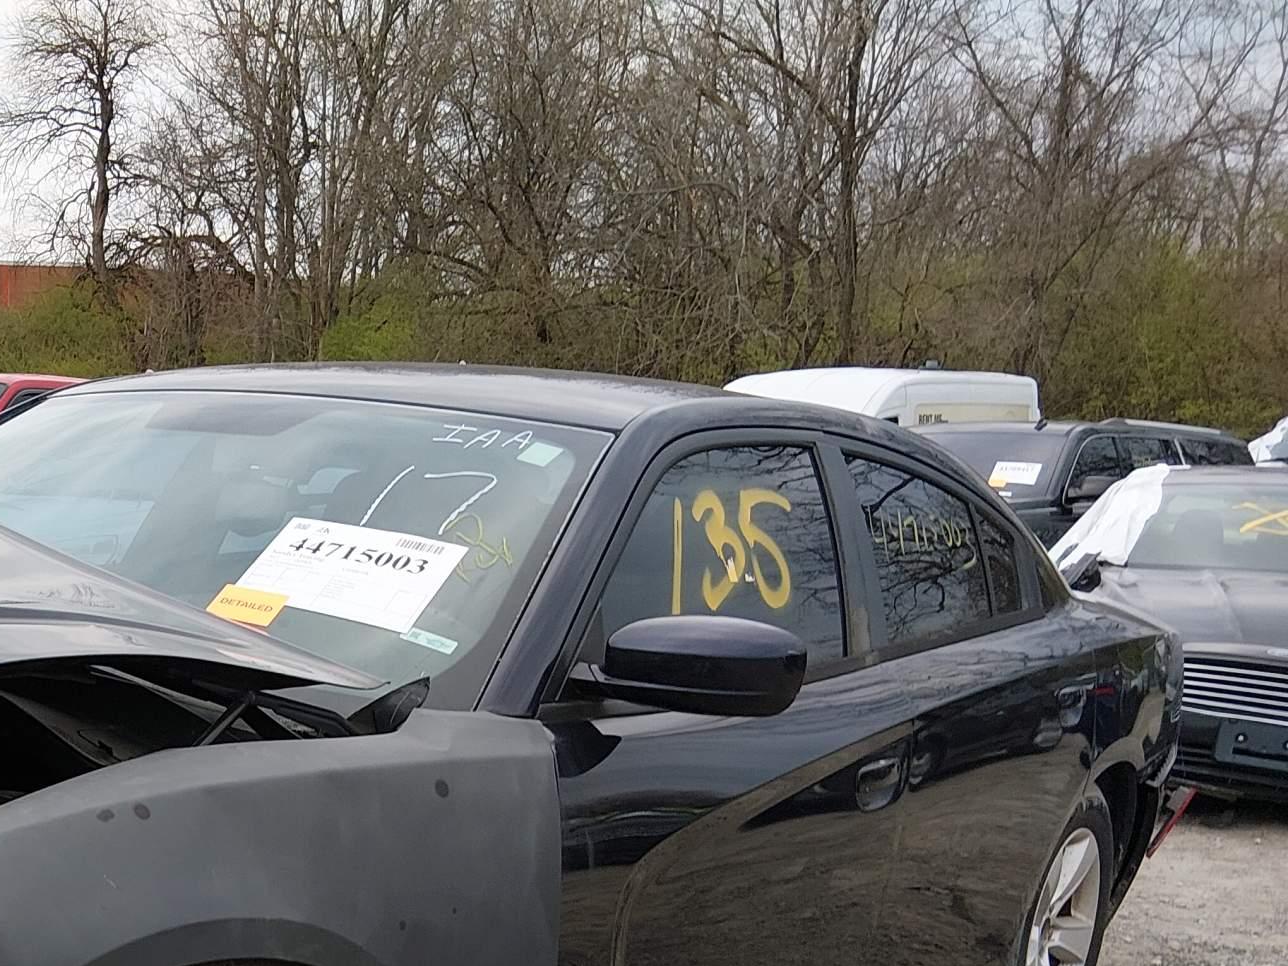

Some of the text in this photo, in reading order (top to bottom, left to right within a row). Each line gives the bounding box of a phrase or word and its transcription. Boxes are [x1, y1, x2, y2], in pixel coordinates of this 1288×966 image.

[432, 423, 533, 449] IAA
[360, 465, 498, 535] 17
[288, 537, 429, 575] 44715003
[671, 489, 792, 615] 135
[219, 597, 274, 613] DETAILED
